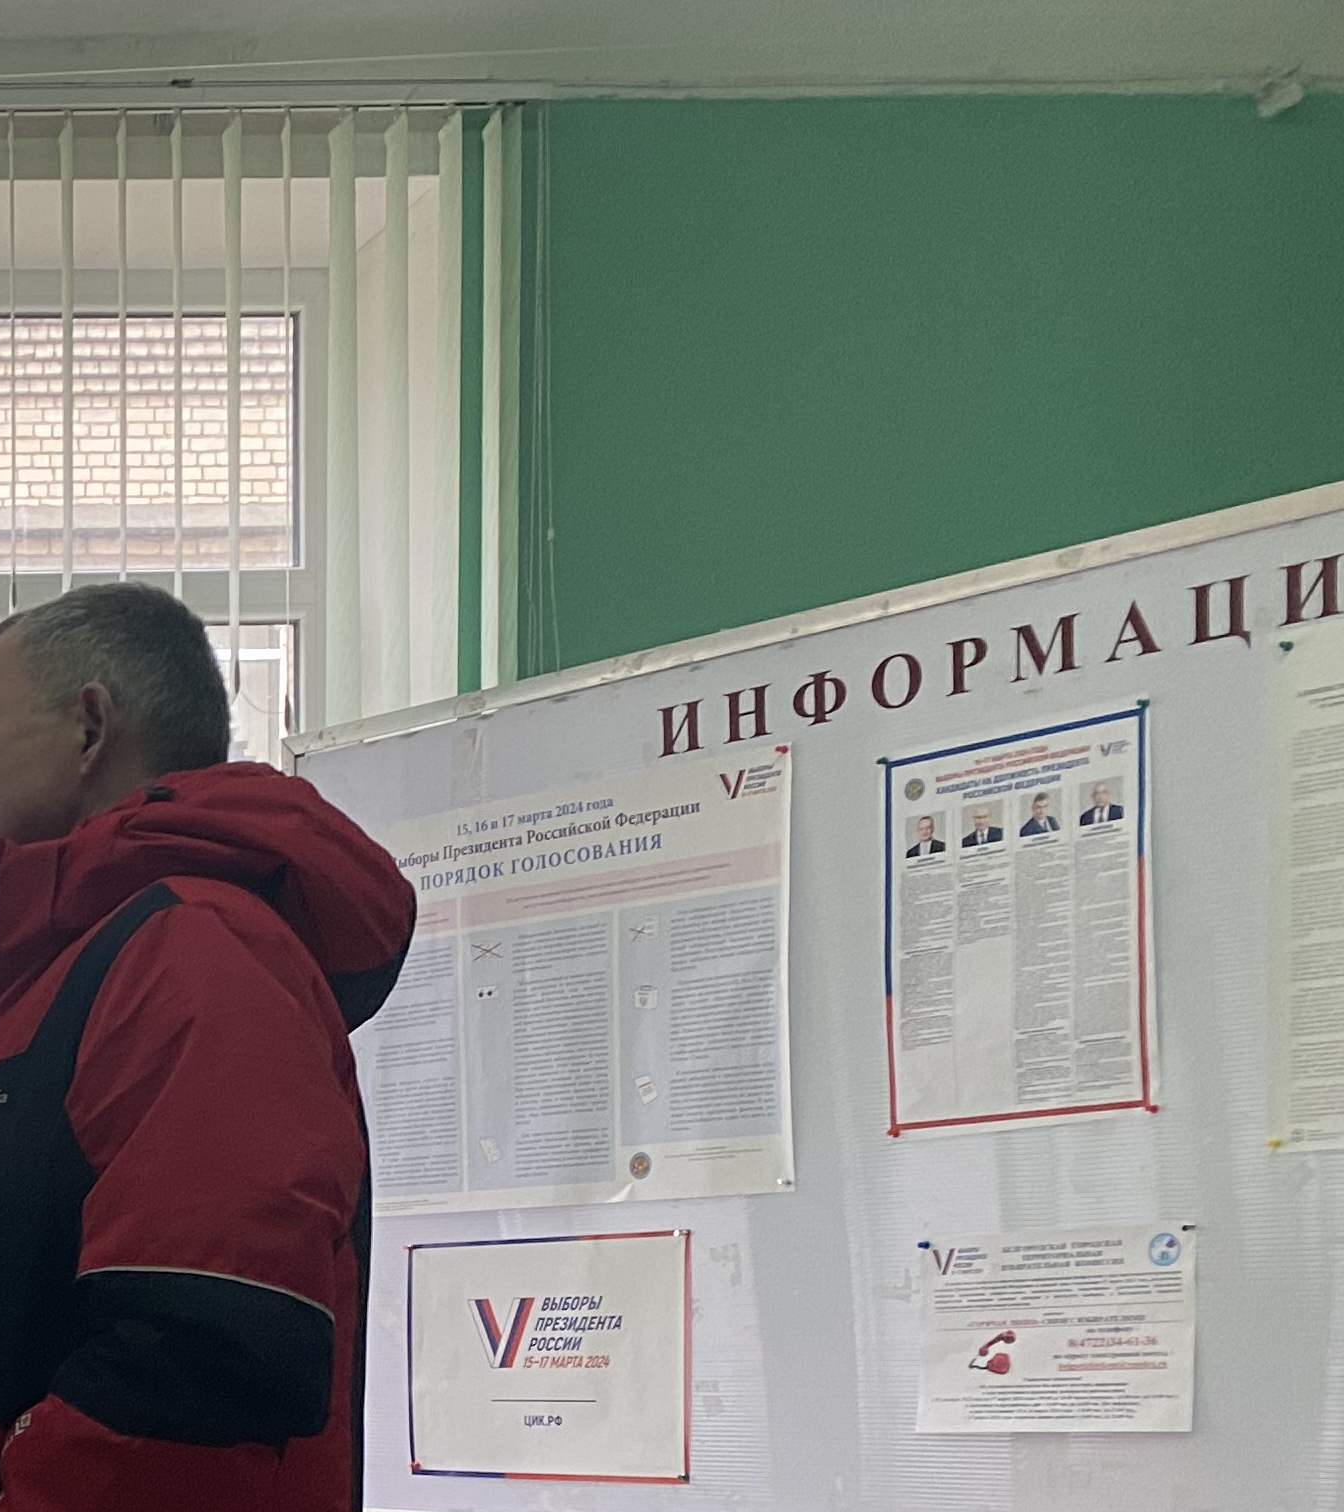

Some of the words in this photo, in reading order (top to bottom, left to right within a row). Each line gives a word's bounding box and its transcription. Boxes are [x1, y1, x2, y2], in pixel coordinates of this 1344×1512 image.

[657, 553, 1344, 758] ИНФОРМАЦИ
[457, 823, 472, 837] 15,
[475, 820, 488, 833] 16
[491, 821, 499, 830] и
[502, 814, 515, 828] 17
[517, 810, 553, 826] марта
[556, 801, 583, 817] 2024
[586, 798, 614, 812] года
[443, 833, 522, 862] Президента
[527, 816, 611, 845] Российской
[615, 801, 701, 830] Федерации
[421, 861, 504, 891] ПОРЯДОК
[511, 833, 663, 875] ГОЛОСОВАНИЯ
[541, 1295, 603, 1312] ВЫБОРЫ
[534, 1315, 623, 1333] ПРЕЗИДЕНТА
[528, 1337, 583, 1351] РОССИИ
[550, 1355, 583, 1369] МАРТА
[584, 1355, 610, 1368] 2024
[524, 1415, 563, 1427] ЦИК.РФ
